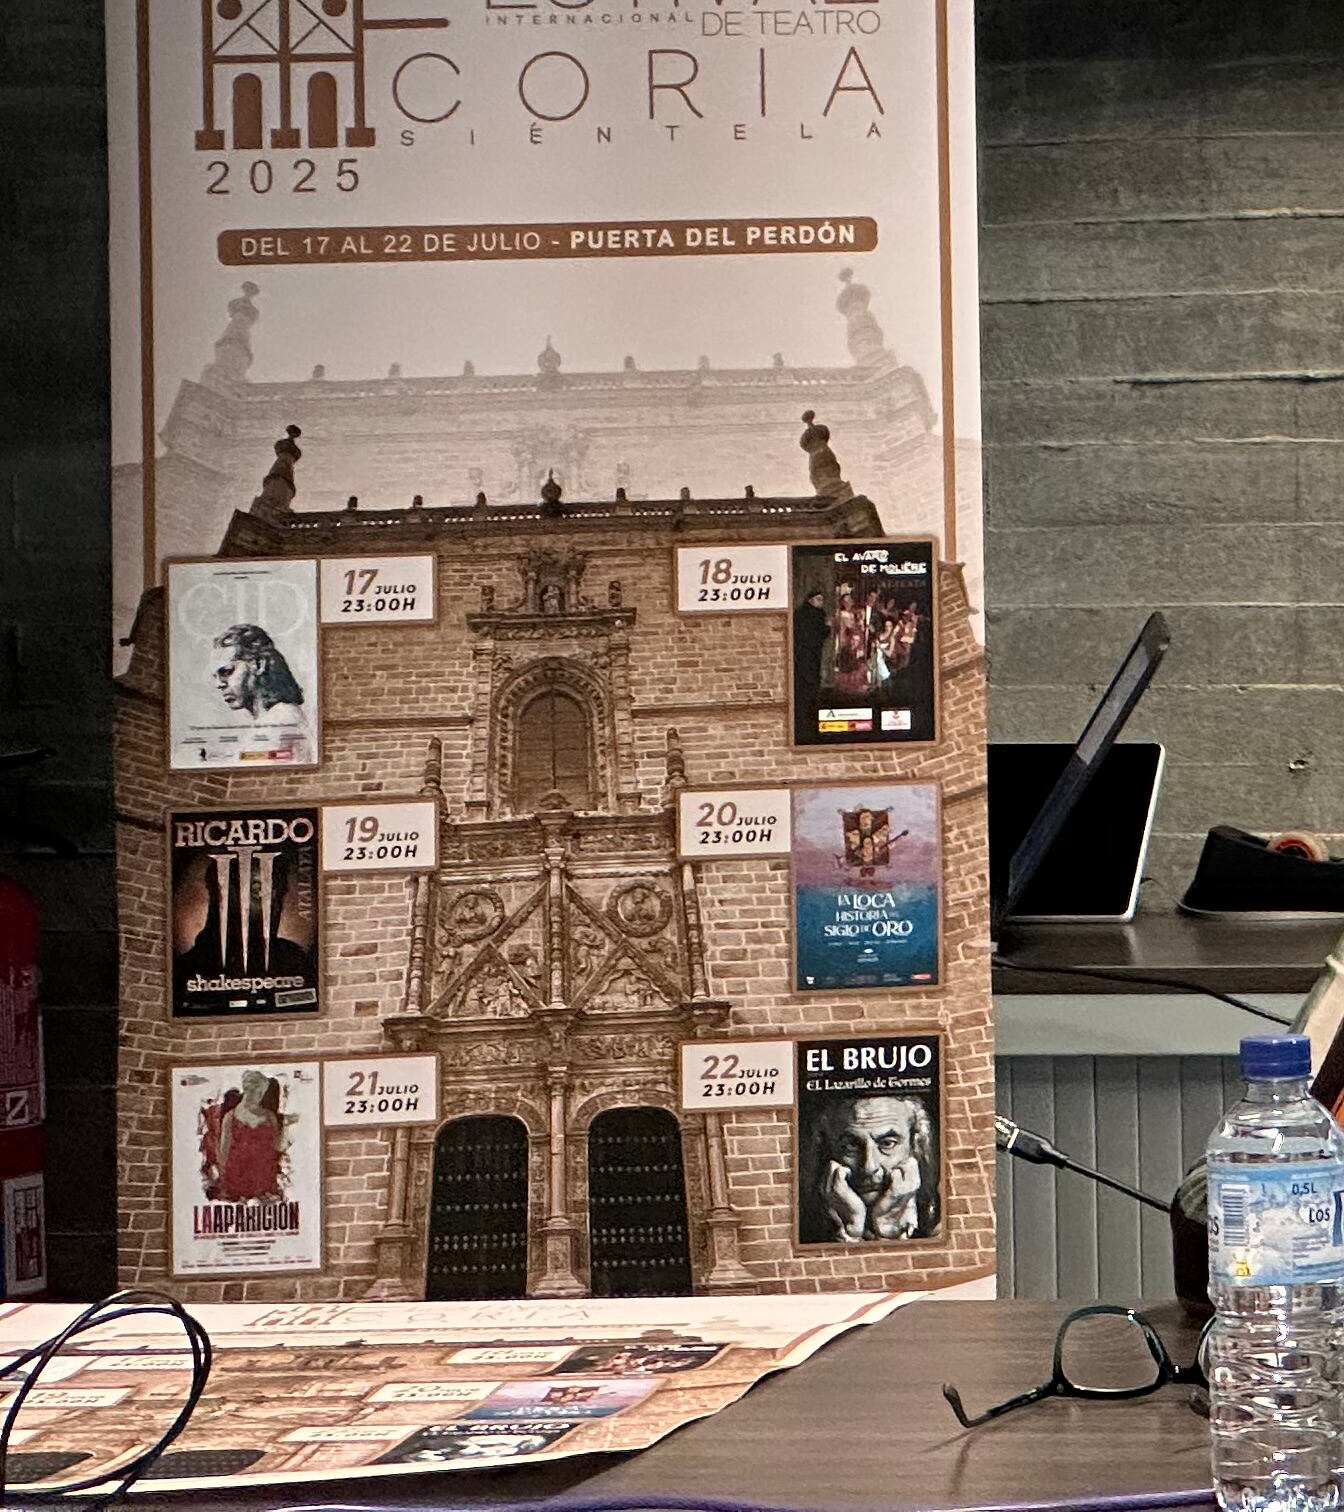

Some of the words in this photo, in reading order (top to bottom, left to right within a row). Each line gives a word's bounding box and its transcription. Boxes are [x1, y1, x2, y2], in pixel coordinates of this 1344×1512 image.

[485, 11, 694, 26] INTERNACIONAL
[701, 11, 748, 37] DE
[753, 8, 882, 37] TEATRO
[392, 47, 886, 125] CORIA
[400, 121, 882, 148] SIÉNTELA
[205, 158, 362, 196] 2025
[241, 237, 289, 257] DEL
[303, 236, 330, 255] 17
[341, 236, 373, 254] AL
[384, 235, 413, 253] 22
[424, 233, 457, 253] DE
[467, 231, 541, 252] JULIO
[570, 228, 675, 250] PUERTA
[686, 227, 736, 248] DEL
[747, 221, 856, 245] PERDÓN
[344, 568, 379, 595] 17
[375, 584, 417, 595] JULIO
[699, 558, 732, 585] 18
[732, 574, 772, 585] JULIO
[341, 597, 416, 613] 23:00H
[698, 587, 770, 603] 23:00H
[696, 801, 737, 828] 20
[736, 815, 777, 827] JULIO
[175, 817, 314, 848] RICARDO
[345, 816, 379, 844] 19
[378, 831, 419, 842] JULIO
[700, 829, 772, 845] 23:00H
[344, 844, 417, 861] 23:00H
[853, 893, 896, 910] LOCA
[872, 920, 913, 937] ORO
[187, 974, 304, 994] shakespeare
[700, 1054, 740, 1080] 22
[739, 1067, 779, 1078] JULIO
[806, 1049, 834, 1072] EL
[843, 1044, 932, 1073] BRUJO
[346, 1071, 379, 1097] 21
[378, 1084, 419, 1095] JULIO
[702, 1081, 775, 1097] 23:00H
[344, 1097, 418, 1114] 23:00H
